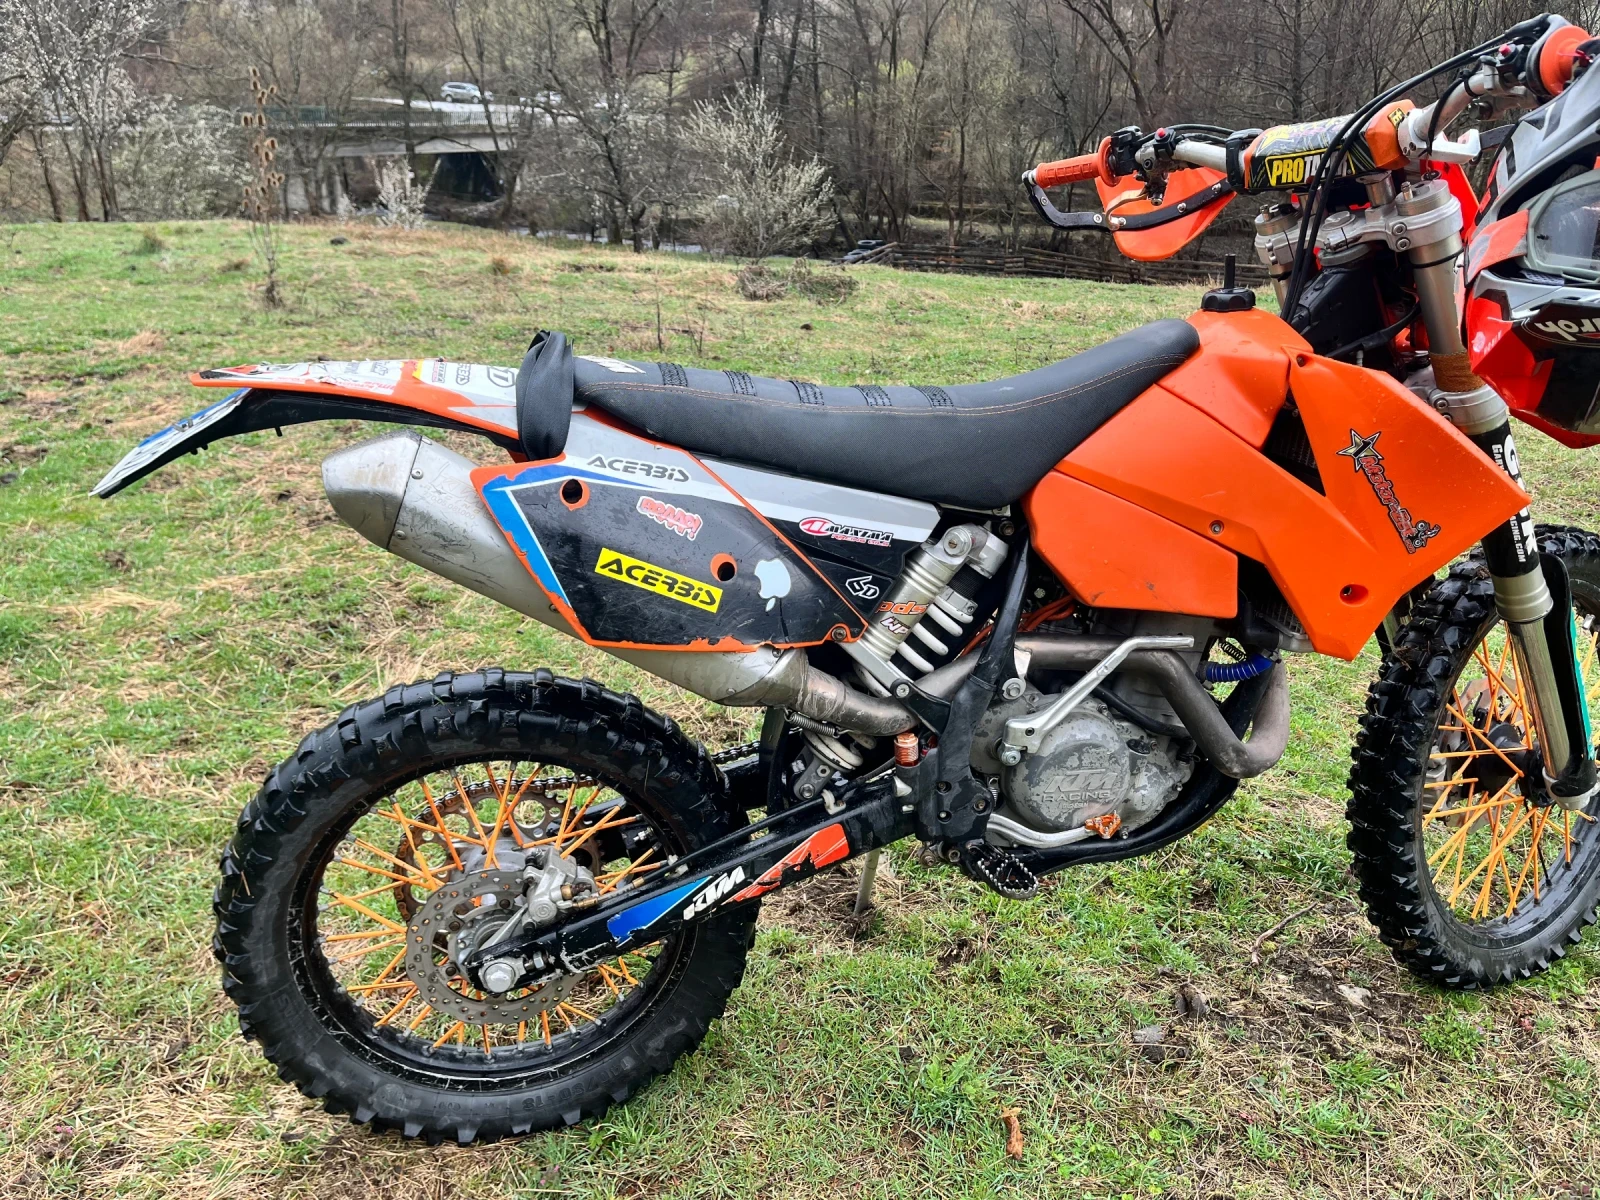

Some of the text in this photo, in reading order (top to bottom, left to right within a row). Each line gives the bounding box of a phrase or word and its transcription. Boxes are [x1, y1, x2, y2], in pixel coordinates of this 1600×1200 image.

[587, 456, 690, 483] ACERBIS
[600, 557, 717, 606] ACERBIS
[1044, 768, 1118, 793] KTM
[1042, 789, 1111, 802] RACING
[682, 865, 746, 921] KTM
